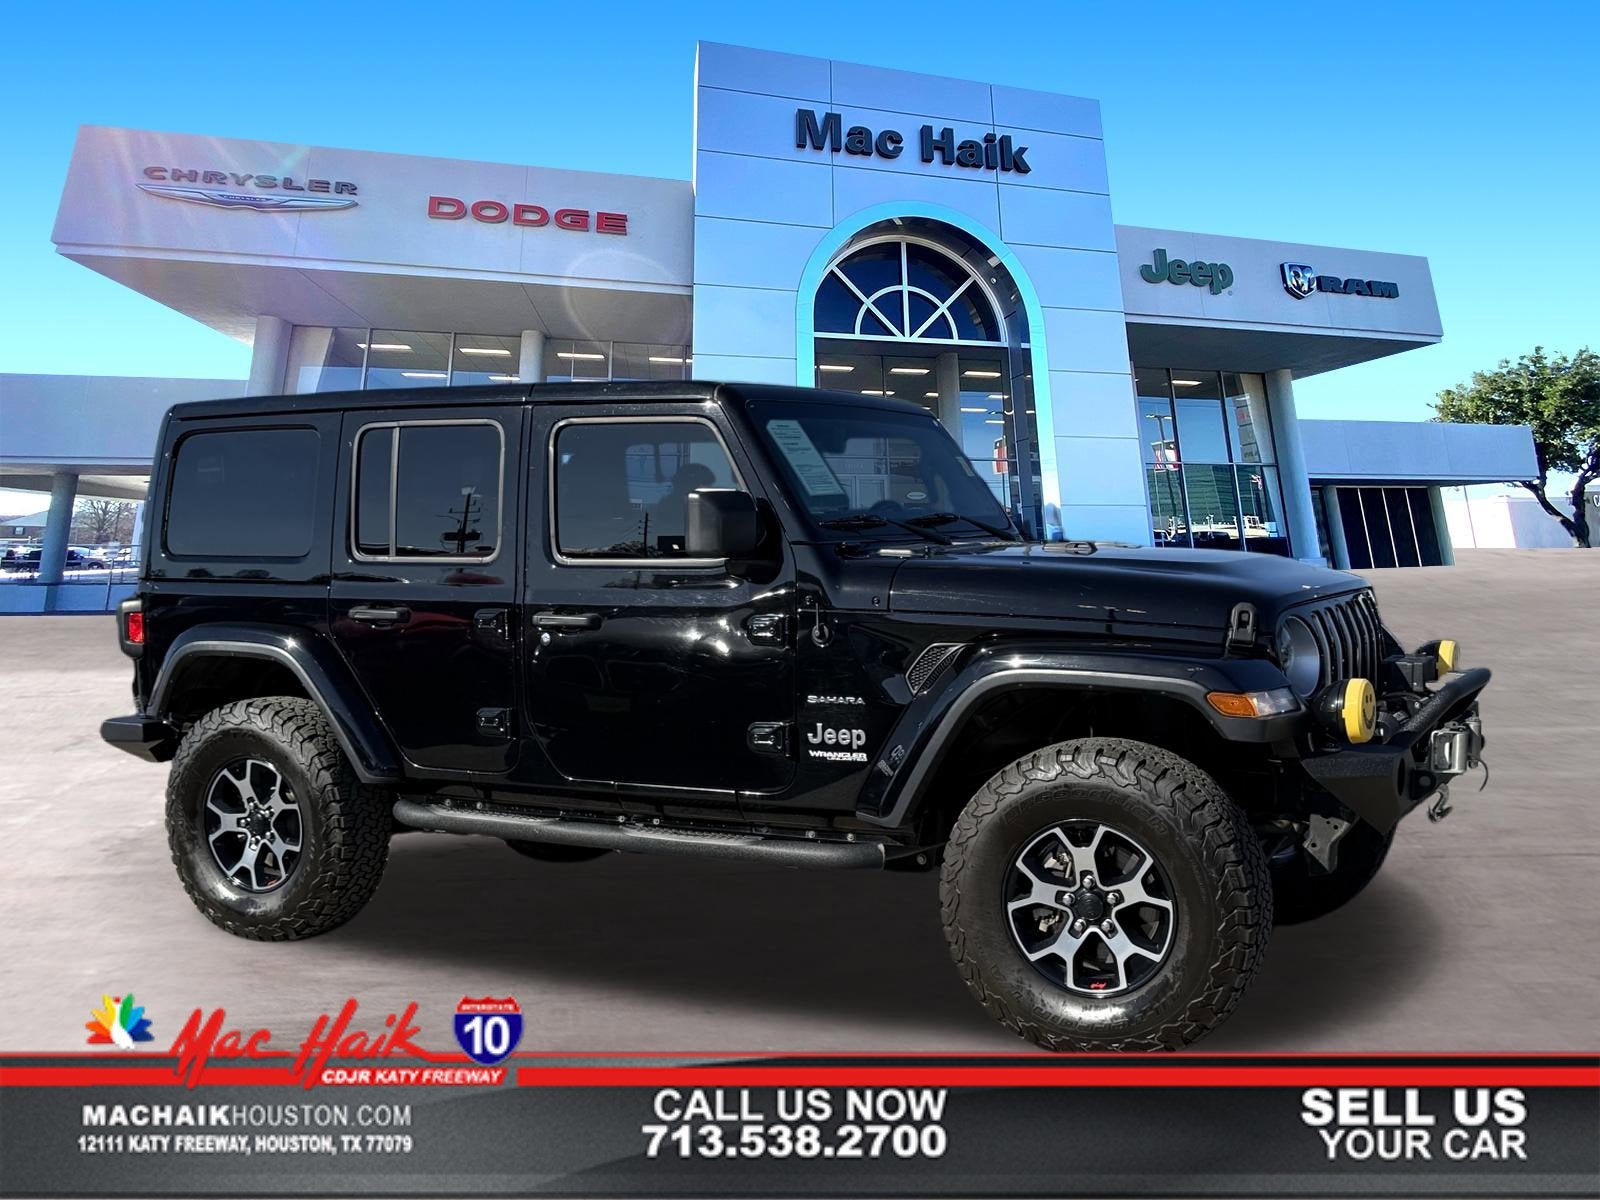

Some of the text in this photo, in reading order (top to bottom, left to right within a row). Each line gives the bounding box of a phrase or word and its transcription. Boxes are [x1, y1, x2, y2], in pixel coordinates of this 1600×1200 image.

[796, 108, 1032, 175] Mac Haik
[142, 165, 358, 196] CHRYSLER
[428, 195, 628, 236] DODGE
[1139, 248, 1234, 295] Jeep
[1315, 275, 1400, 298] RAM
[807, 695, 866, 705] SAHARA
[807, 722, 866, 750] Jeep
[808, 749, 867, 759] WRANGLER
